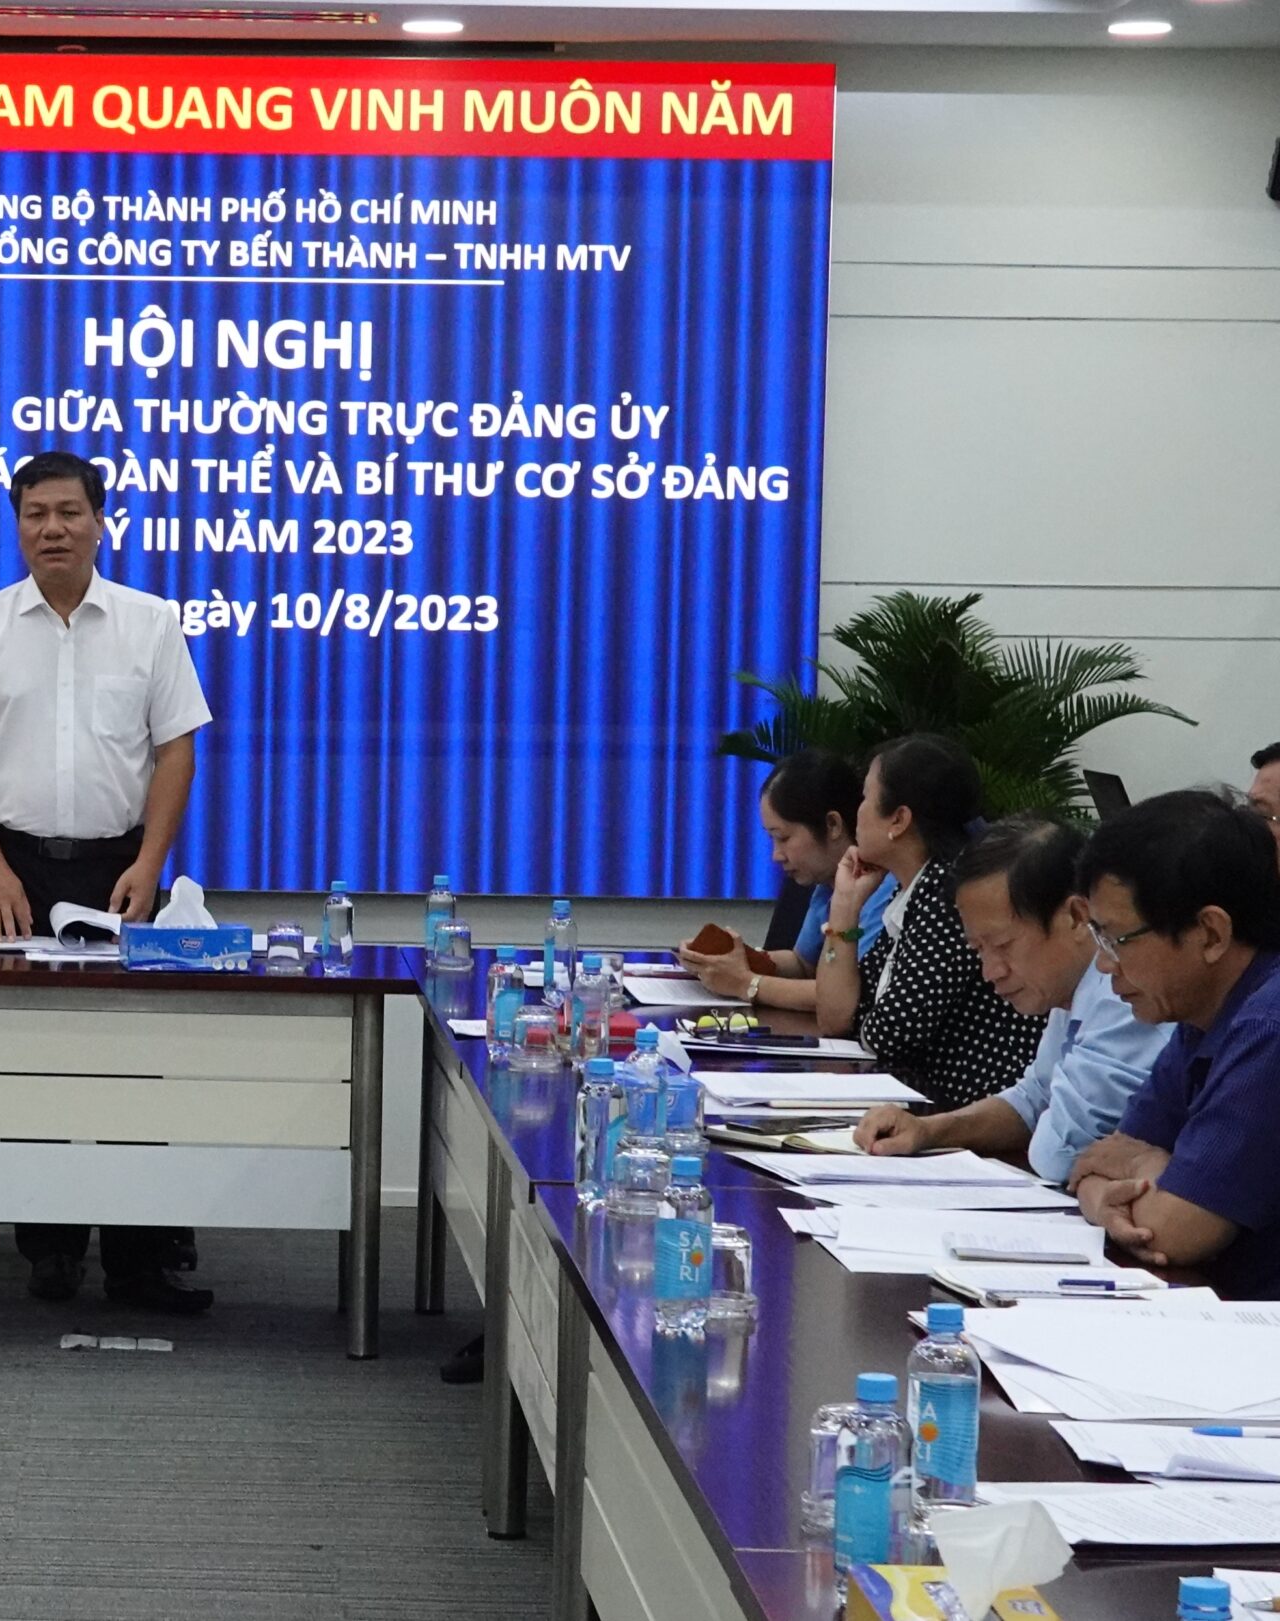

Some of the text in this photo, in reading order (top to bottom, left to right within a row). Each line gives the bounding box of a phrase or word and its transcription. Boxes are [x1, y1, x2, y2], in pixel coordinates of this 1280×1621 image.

[92, 84, 293, 135] QUANG
[310, 85, 445, 132] VINH
[463, 78, 642, 134] MUÔN
[661, 79, 793, 136] NĂM
[51, 188, 96, 227] BỘ
[102, 189, 212, 223] THÀNH
[220, 187, 287, 223] PHỐ
[295, 188, 342, 224] HỒ
[349, 192, 404, 225] CHÍ
[410, 199, 497, 226] MINH
[77, 231, 172, 267] CÔNG
[180, 239, 221, 267] TY
[229, 229, 293, 268] BẾN
[301, 234, 417, 270] THÀNH
[453, 242, 546, 271] TNHH
[556, 243, 632, 272] MTV
[84, 304, 373, 382] HỘI NGHỊ
[11, 388, 124, 433] GIỮA
[133, 390, 328, 436] THƯỜNG
[339, 399, 459, 445] TRỰC
[468, 390, 597, 440] ĐẢNG
[610, 391, 670, 440] ỦY
[190, 443, 276, 494] THỂ
[284, 450, 343, 495] VÀ
[355, 451, 399, 496] BÍ
[406, 460, 505, 498] THƯ
[514, 460, 582, 499] CƠ
[591, 451, 656, 500] SỞ
[661, 452, 789, 502] ĐẢNG
[143, 517, 180, 552] III
[194, 508, 299, 554] NĂM
[312, 518, 414, 556] 2023
[270, 588, 499, 638] 10/8/2023
